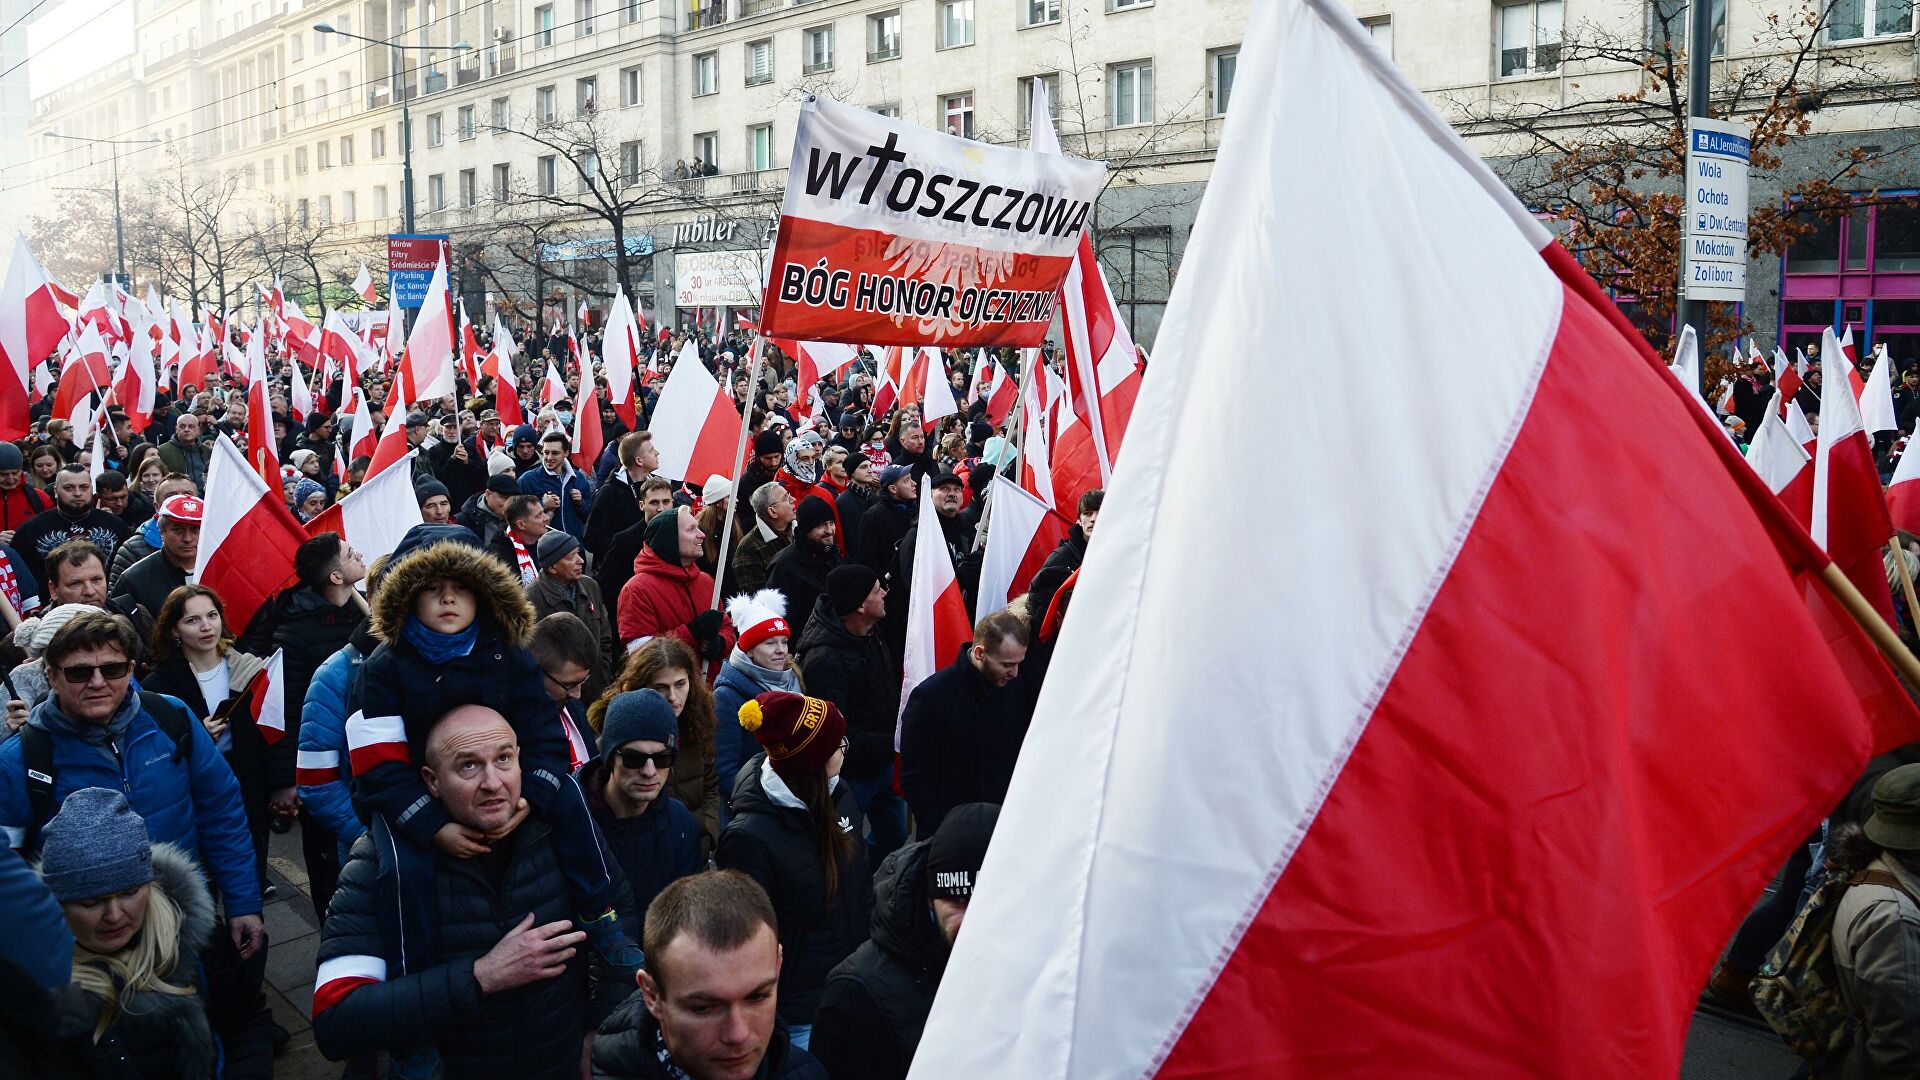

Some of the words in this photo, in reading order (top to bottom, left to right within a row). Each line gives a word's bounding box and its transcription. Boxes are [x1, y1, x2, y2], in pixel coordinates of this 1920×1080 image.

[1699, 162, 1722, 179] Wola
[1698, 188, 1729, 206] Ochota
[391, 251, 408, 259] Filtry
[1695, 239, 1735, 257] Mokotów
[391, 260, 430, 268] Śródmieście
[400, 272, 424, 280] Parking
[1695, 263, 1733, 282] Żoliborz
[407, 282, 429, 291] Konsty
[691, 276, 702, 289] 30
[396, 292, 406, 300] lac
[780, 257, 851, 308] BÓG
[854, 274, 954, 319] HONOR
[959, 288, 1056, 328] OJCZYZNA
[936, 870, 971, 888] STOMIL
